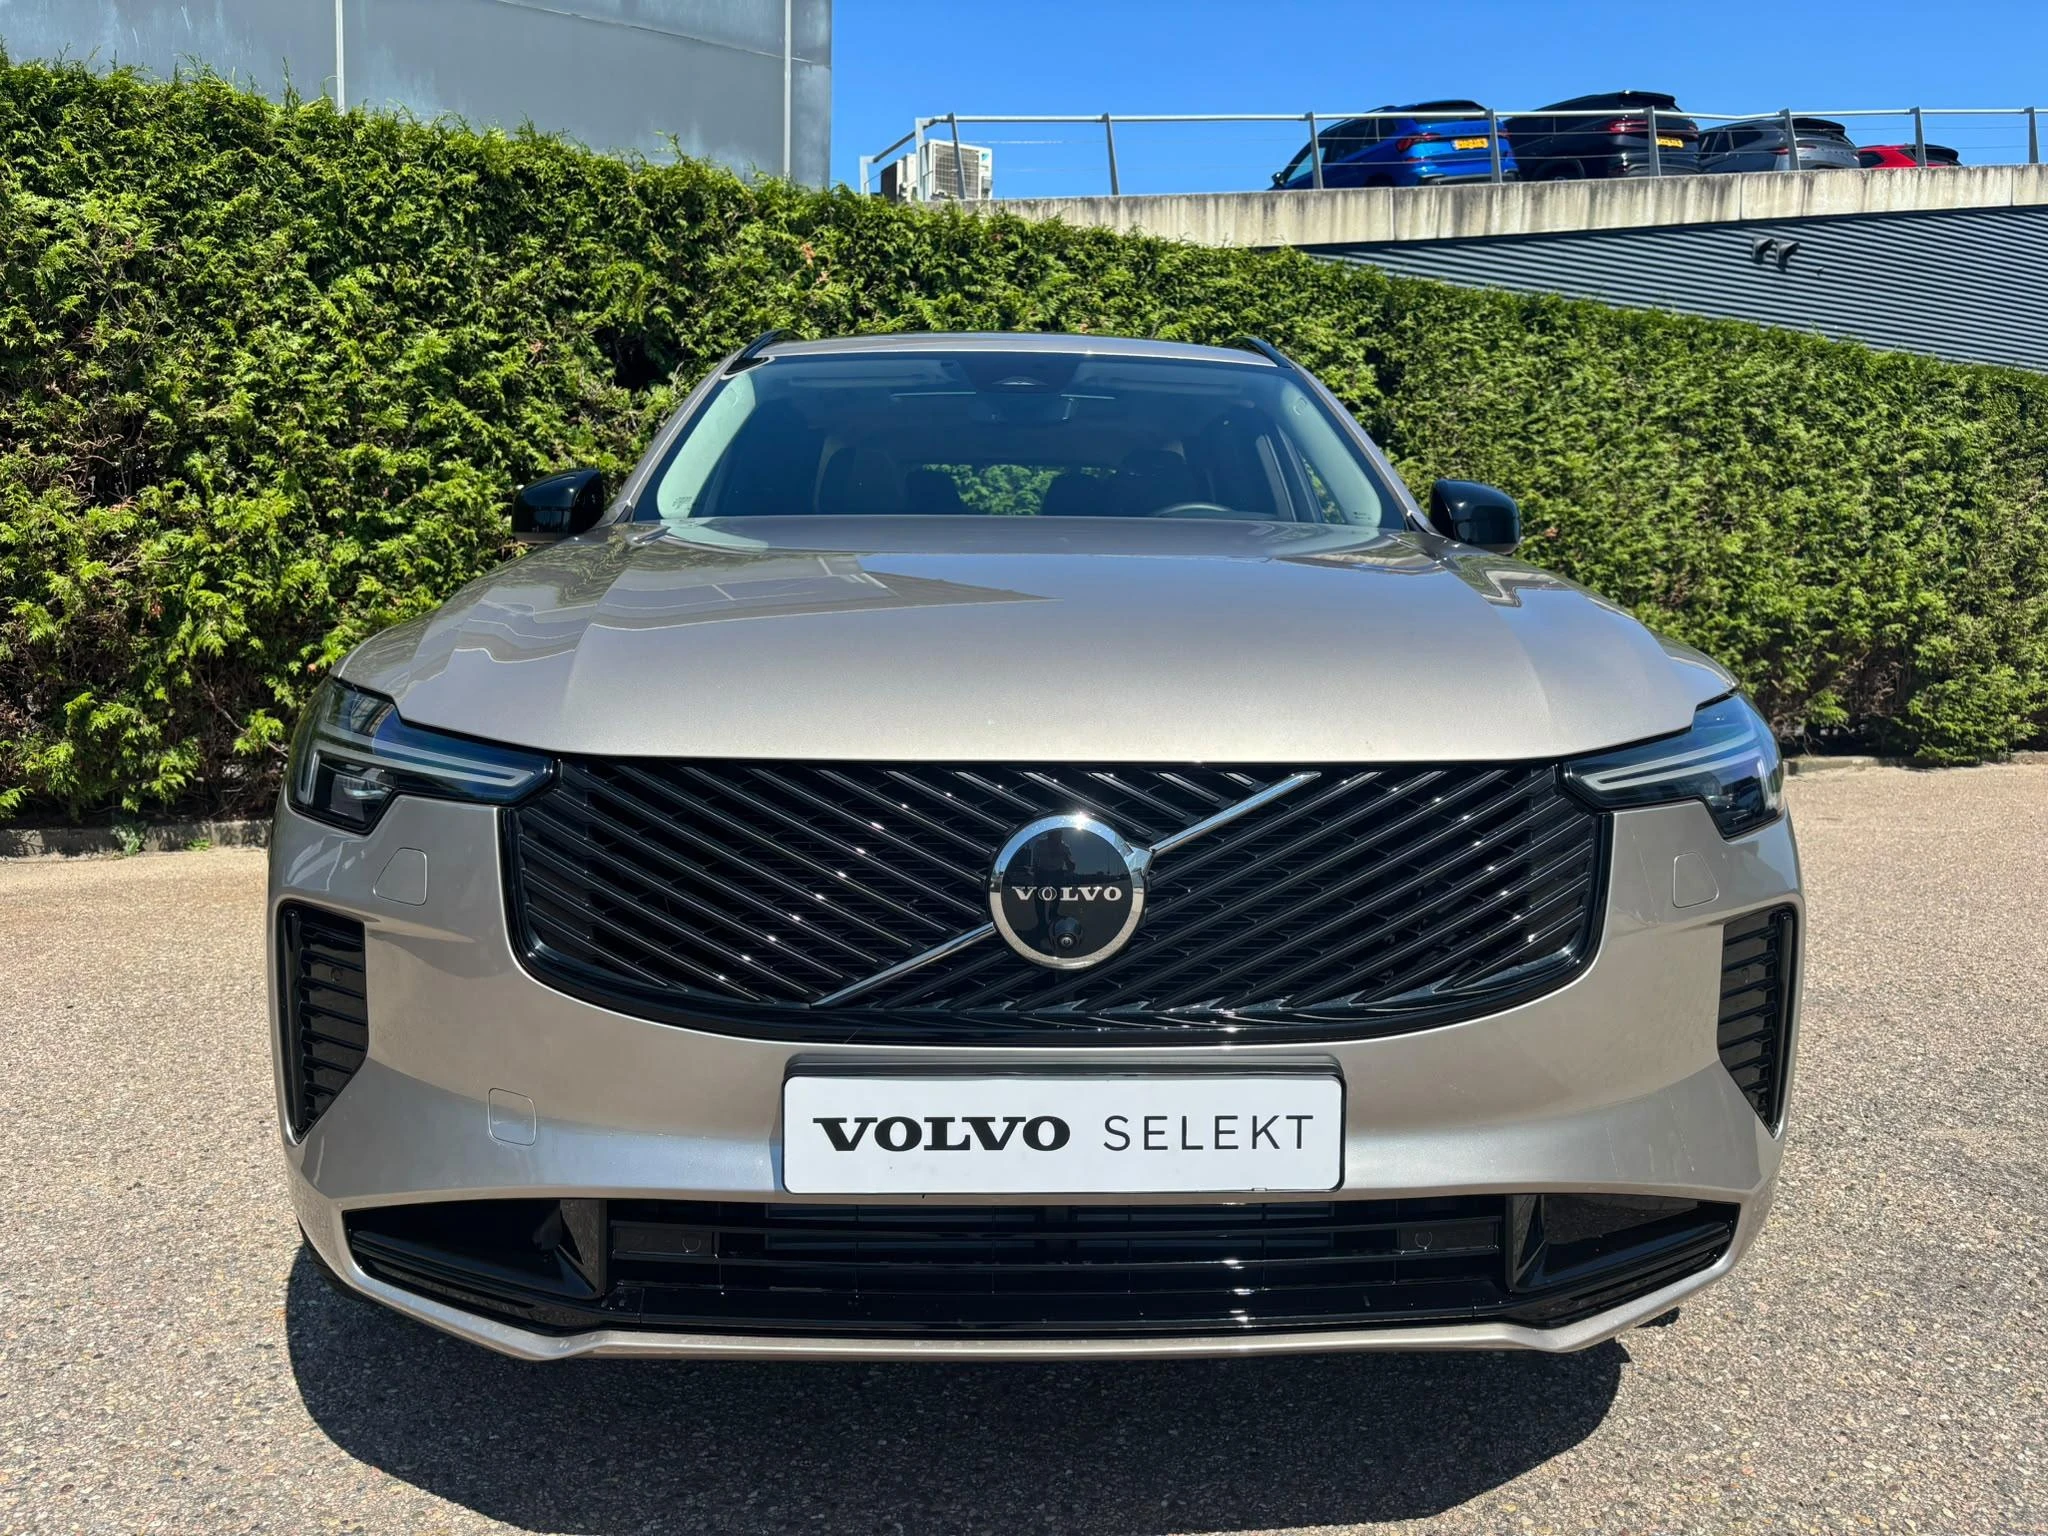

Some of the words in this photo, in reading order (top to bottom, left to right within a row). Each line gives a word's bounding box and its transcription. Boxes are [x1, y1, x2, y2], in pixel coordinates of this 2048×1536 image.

[1011, 886, 1122, 902] VOLVO
[812, 1115, 1071, 1152] VOLVO
[1103, 1114, 1314, 1152] SELEKT
